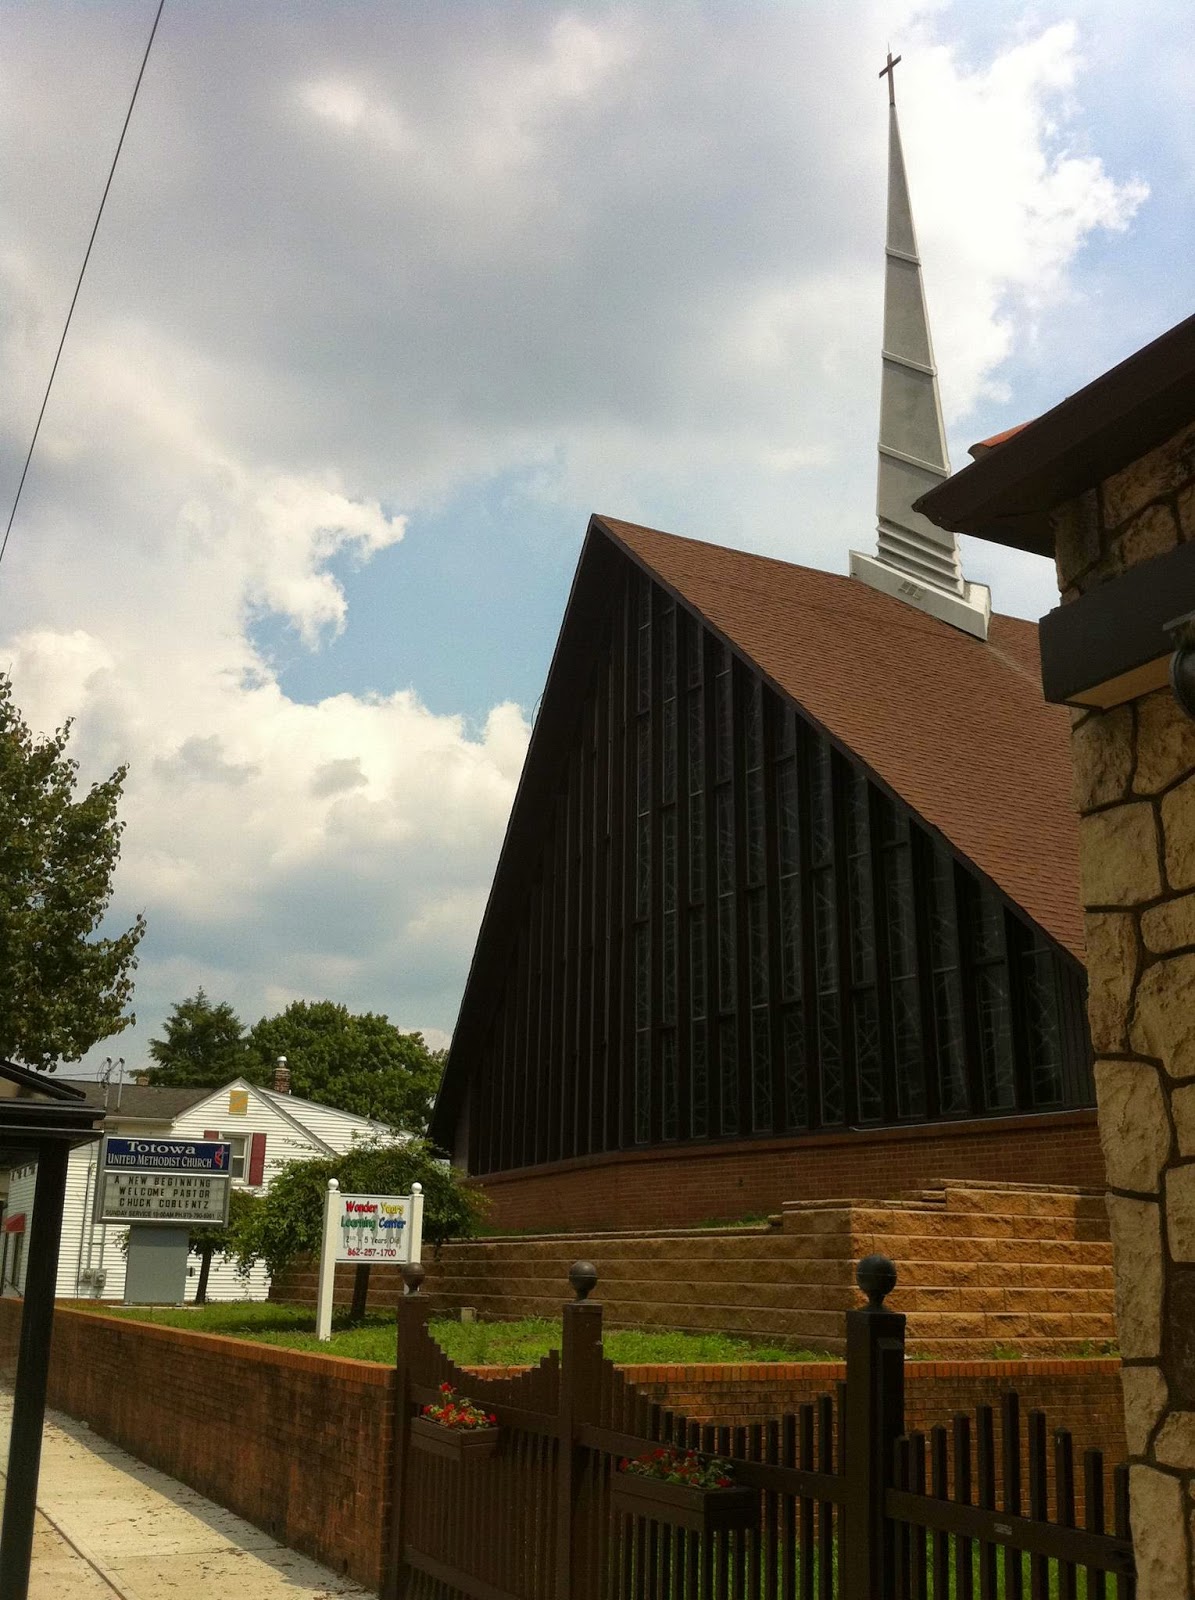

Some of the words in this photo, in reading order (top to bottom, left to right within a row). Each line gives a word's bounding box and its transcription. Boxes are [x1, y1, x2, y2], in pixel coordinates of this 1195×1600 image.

[127, 1140, 196, 1154] Totowa
[108, 1153, 136, 1165] UNITED
[136, 1154, 181, 1166] METHODIST
[182, 1156, 212, 1168] CHURCH
[114, 1176, 120, 1184] A
[129, 1176, 148, 1185] NEW
[154, 1177, 211, 1187] BEGINNING
[119, 1186, 165, 1196] WELCOME
[173, 1188, 210, 1198] PASTOR
[120, 1198, 151, 1208] CHUCK
[346, 1200, 378, 1214] Wonder
[380, 1202, 404, 1214] Years
[340, 1215, 377, 1231] Learning
[378, 1216, 406, 1229] Center
[370, 1237, 388, 1245] Years
[347, 1248, 396, 1257] 862-257-1700
